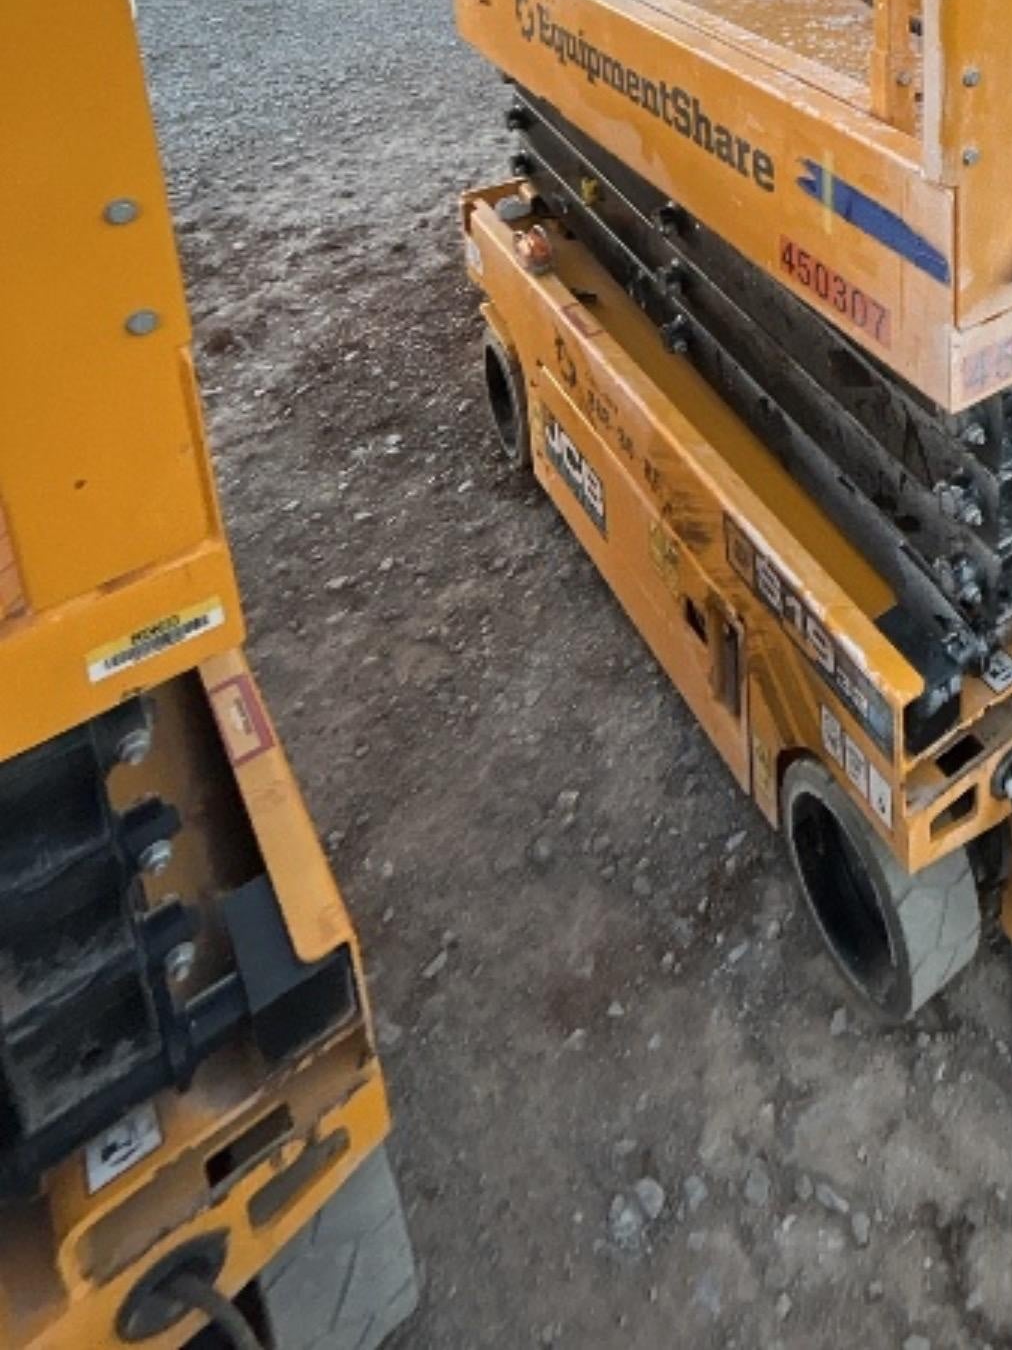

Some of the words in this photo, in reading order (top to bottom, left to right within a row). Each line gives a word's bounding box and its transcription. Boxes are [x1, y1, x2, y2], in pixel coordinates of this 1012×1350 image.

[537, 1, 776, 194] EquipmentShare
[781, 236, 891, 340] 450307
[544, 421, 605, 517] JCB
